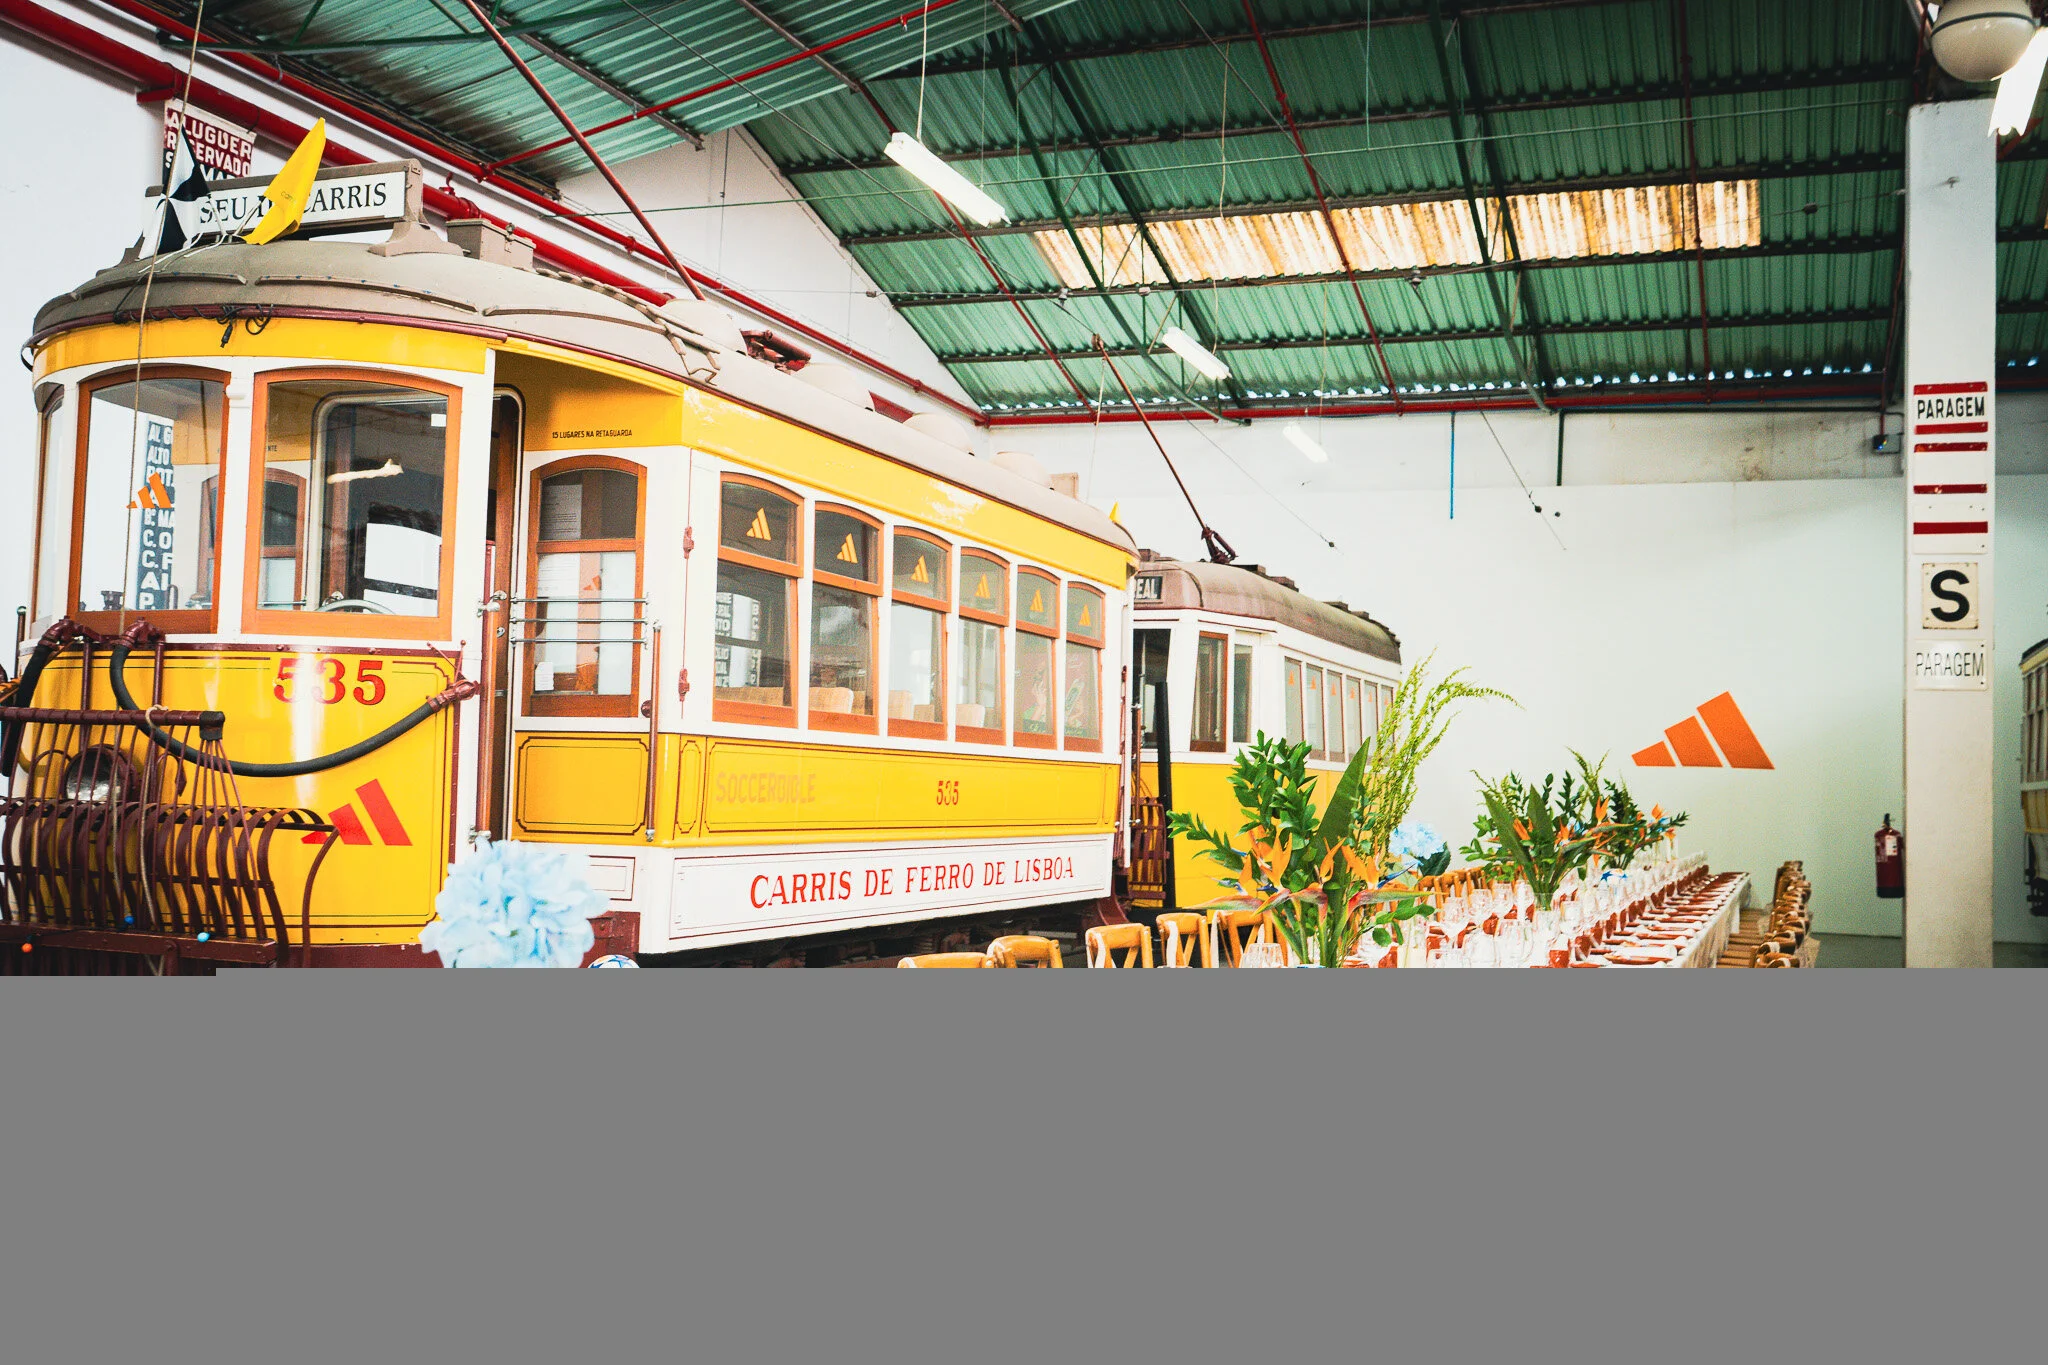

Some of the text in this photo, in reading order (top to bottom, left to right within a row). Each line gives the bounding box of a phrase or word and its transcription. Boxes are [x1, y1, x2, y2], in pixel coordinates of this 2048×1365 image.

[166, 130, 250, 178] RERVADO
[200, 194, 247, 224] SEU
[1917, 396, 1986, 419] PARAGEM
[552, 429, 633, 439] 15 LUGARES NA RETAGUARDA
[1135, 578, 1158, 599] EAL
[1930, 569, 1970, 622] S
[1915, 652, 1985, 677] PARAGEM
[273, 657, 386, 706] 535
[936, 780, 960, 806] 535
[750, 856, 1075, 909] CARRIS DE FERRO DE LISBOA
